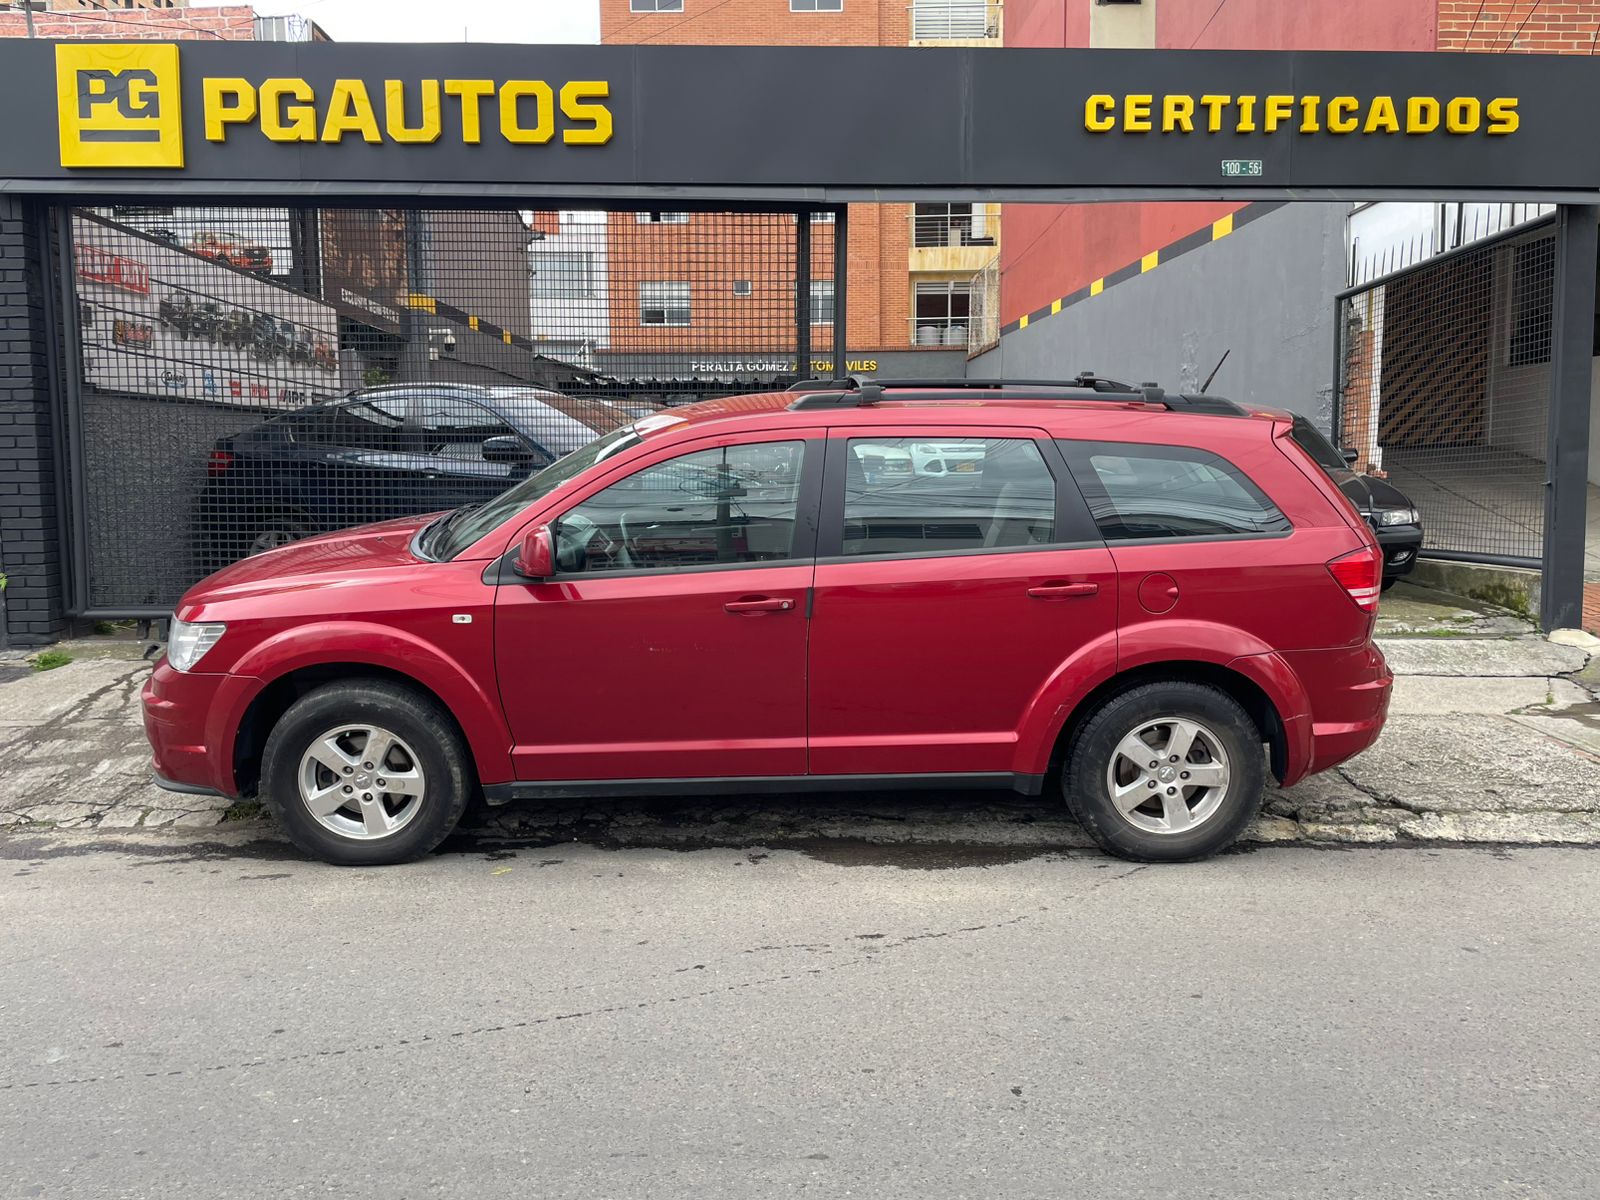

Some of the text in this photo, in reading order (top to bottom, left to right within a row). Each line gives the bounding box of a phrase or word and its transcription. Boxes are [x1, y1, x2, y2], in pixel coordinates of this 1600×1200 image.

[76, 69, 160, 119] PG
[202, 77, 613, 144] PGAUTOS
[1084, 94, 1520, 135] CERTIFICADOS
[1225, 162, 1240, 174] 100
[1248, 162, 1259, 174] 56
[691, 360, 744, 372] PERALTA
